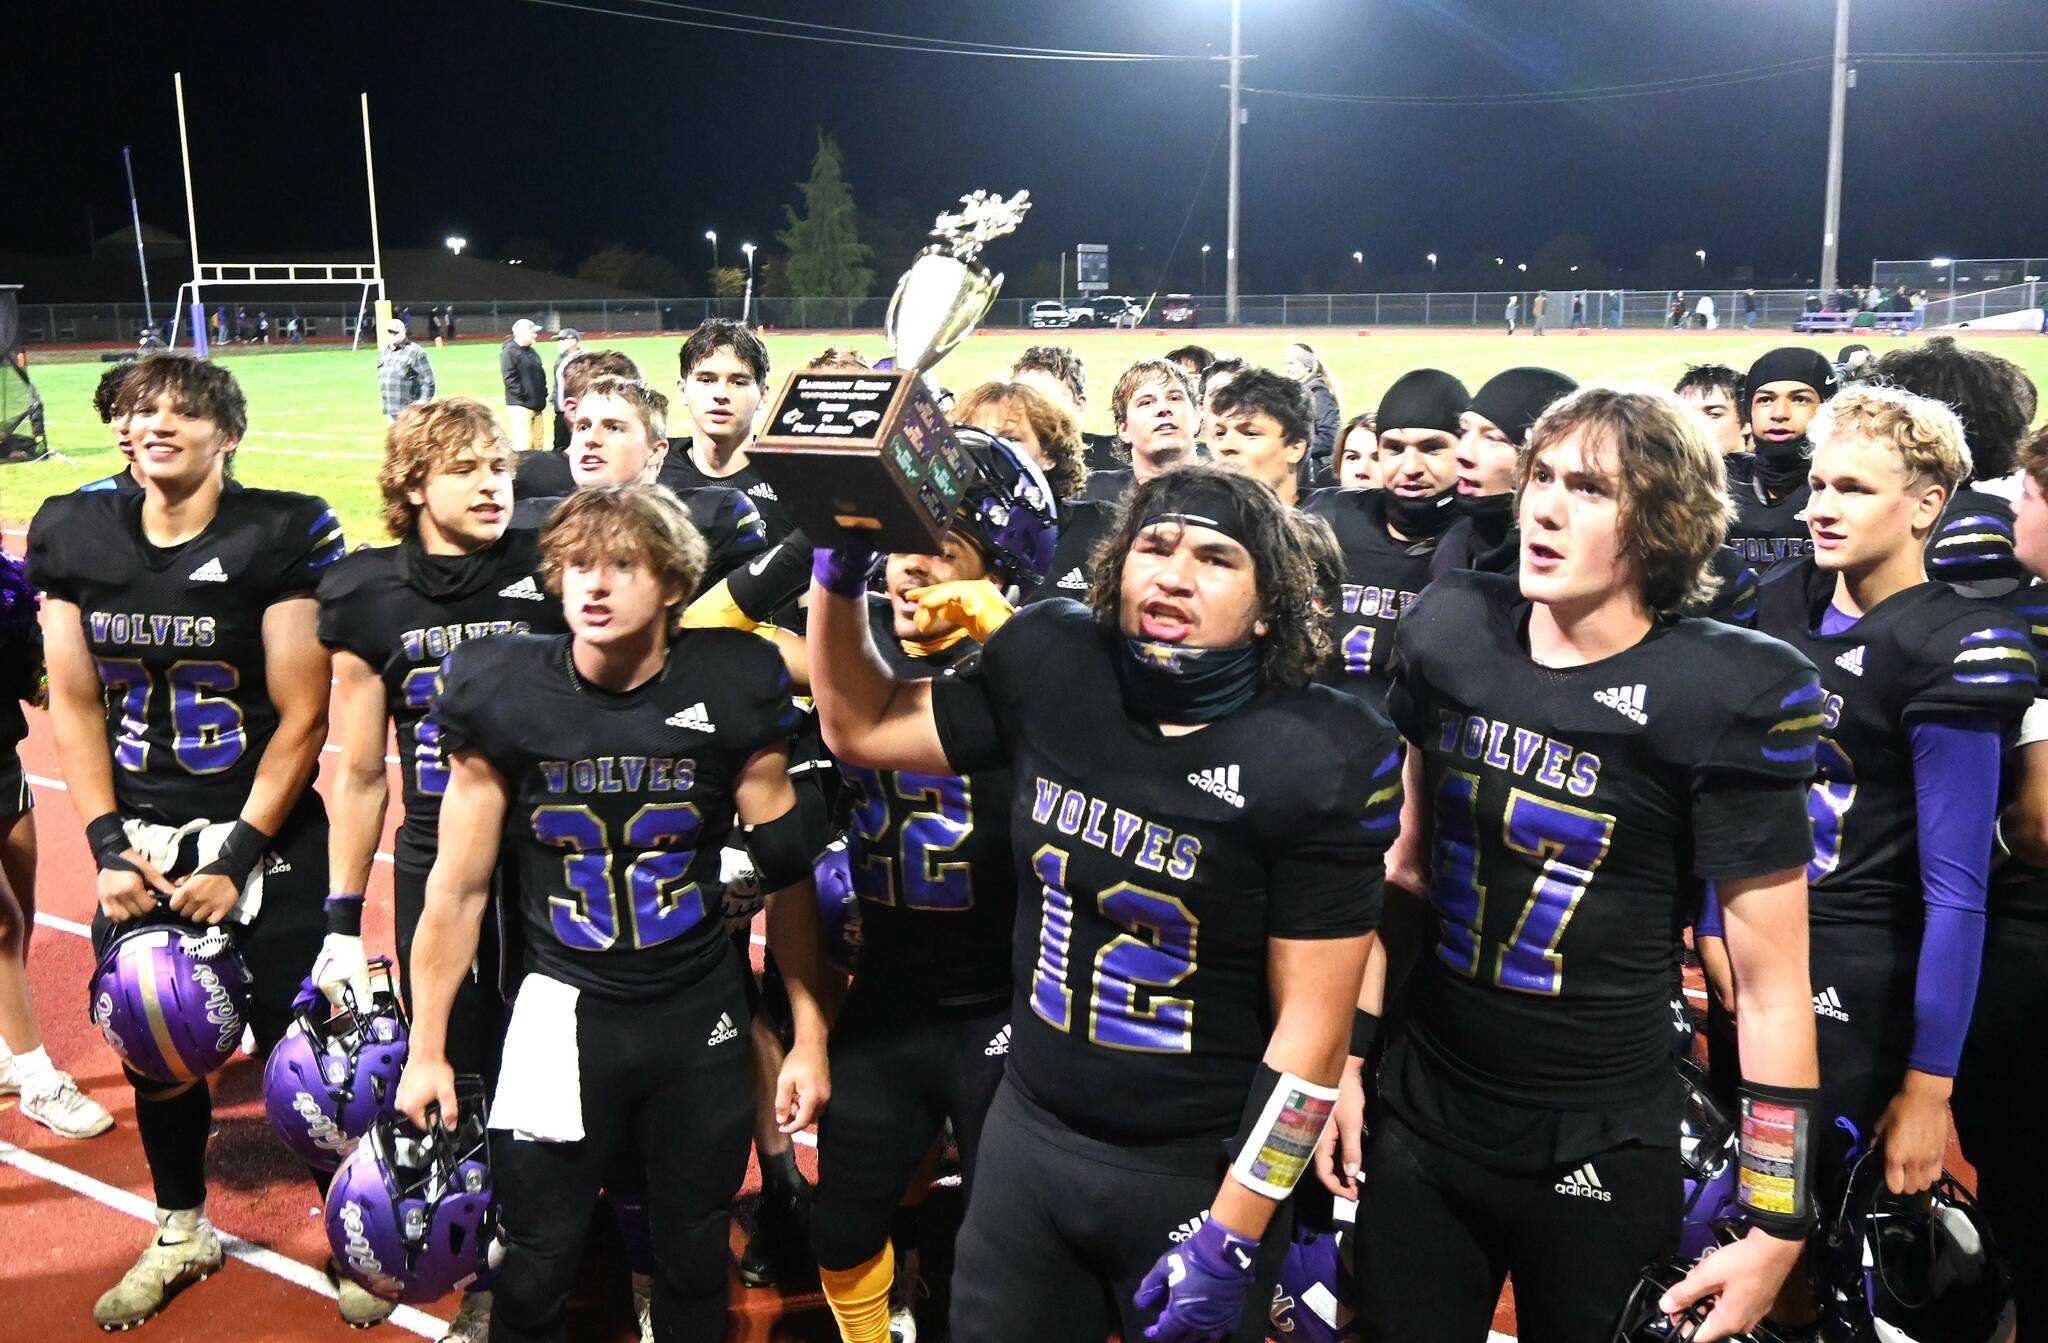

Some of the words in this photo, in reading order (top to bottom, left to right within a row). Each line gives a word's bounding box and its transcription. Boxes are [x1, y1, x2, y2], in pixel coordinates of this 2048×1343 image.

[90, 611, 216, 647] WOLVES
[93, 656, 248, 776] 76
[1439, 708, 1602, 797] WOLVES
[1593, 690, 1648, 726] adidas
[539, 756, 696, 795] WOLVES
[1187, 772, 1246, 809] adidas
[530, 801, 707, 952] 32
[836, 757, 976, 913] 22
[1031, 776, 1202, 881] WOLVES
[1431, 767, 1617, 997] 17
[1029, 842, 1200, 1054] 12
[1554, 1183, 1612, 1202] adidas
